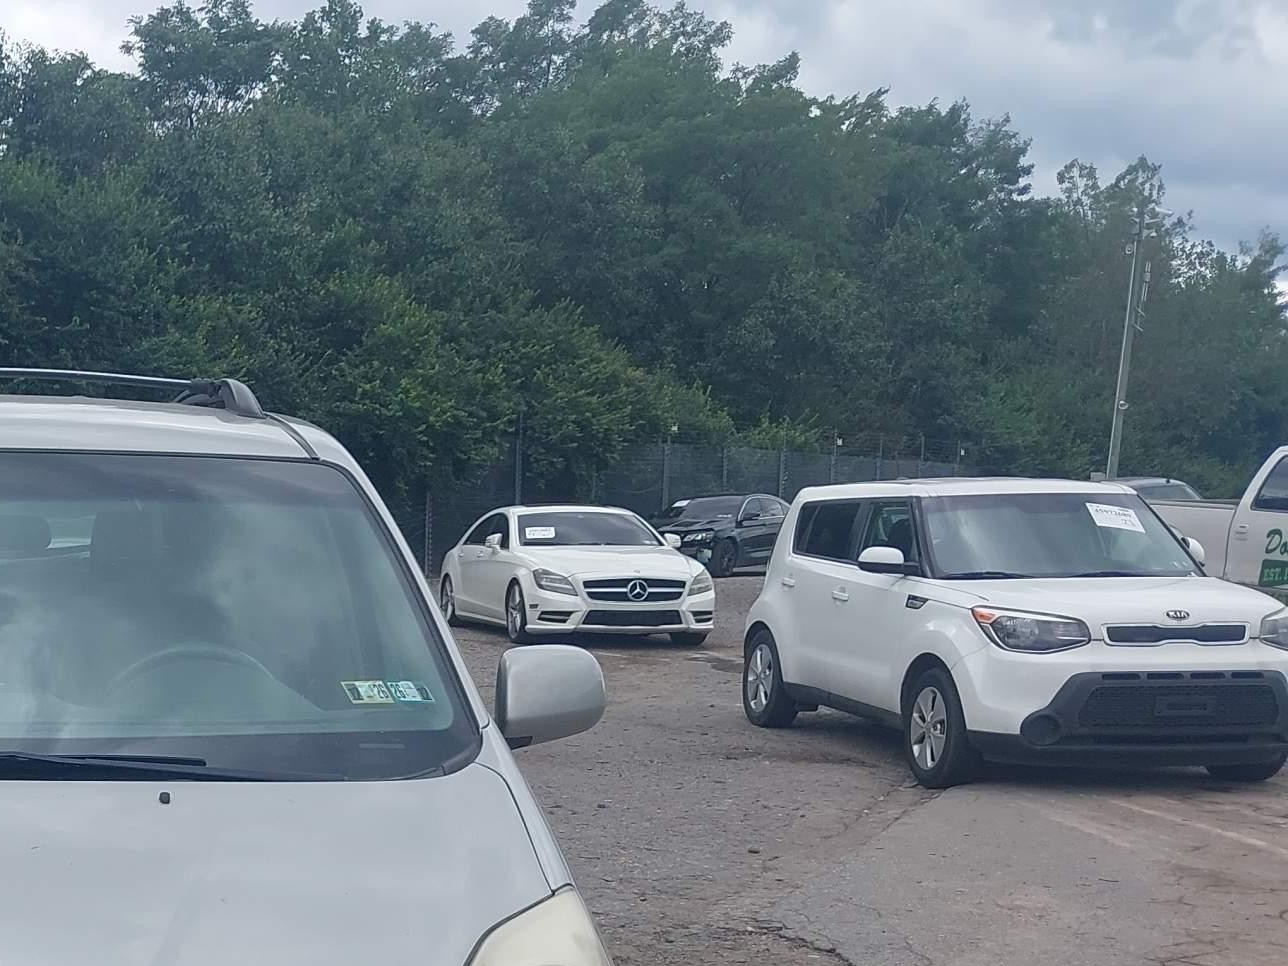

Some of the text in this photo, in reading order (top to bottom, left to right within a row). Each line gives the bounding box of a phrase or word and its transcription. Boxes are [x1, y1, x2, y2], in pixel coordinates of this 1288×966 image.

[1167, 610, 1189, 619] KIA
[372, 683, 389, 699] 26
[390, 683, 406, 699] 26
